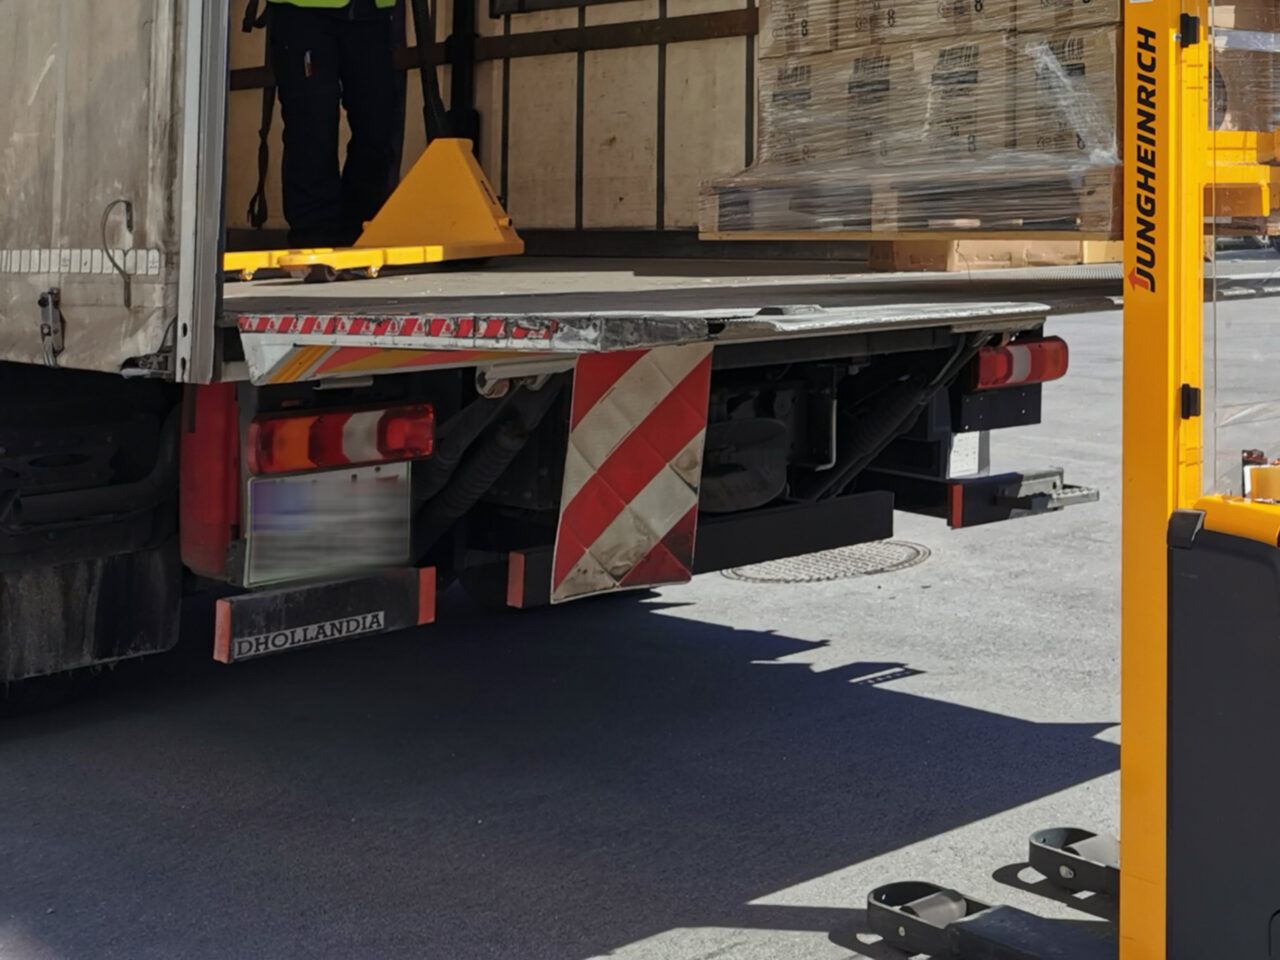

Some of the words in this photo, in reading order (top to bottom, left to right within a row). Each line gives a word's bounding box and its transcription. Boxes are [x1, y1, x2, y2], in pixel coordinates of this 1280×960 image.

[801, 20, 808, 36] 8
[887, 10, 895, 27] 8
[1137, 26, 1157, 293] JUNGHEINRICH
[236, 613, 382, 656] DHOLLANDIA
